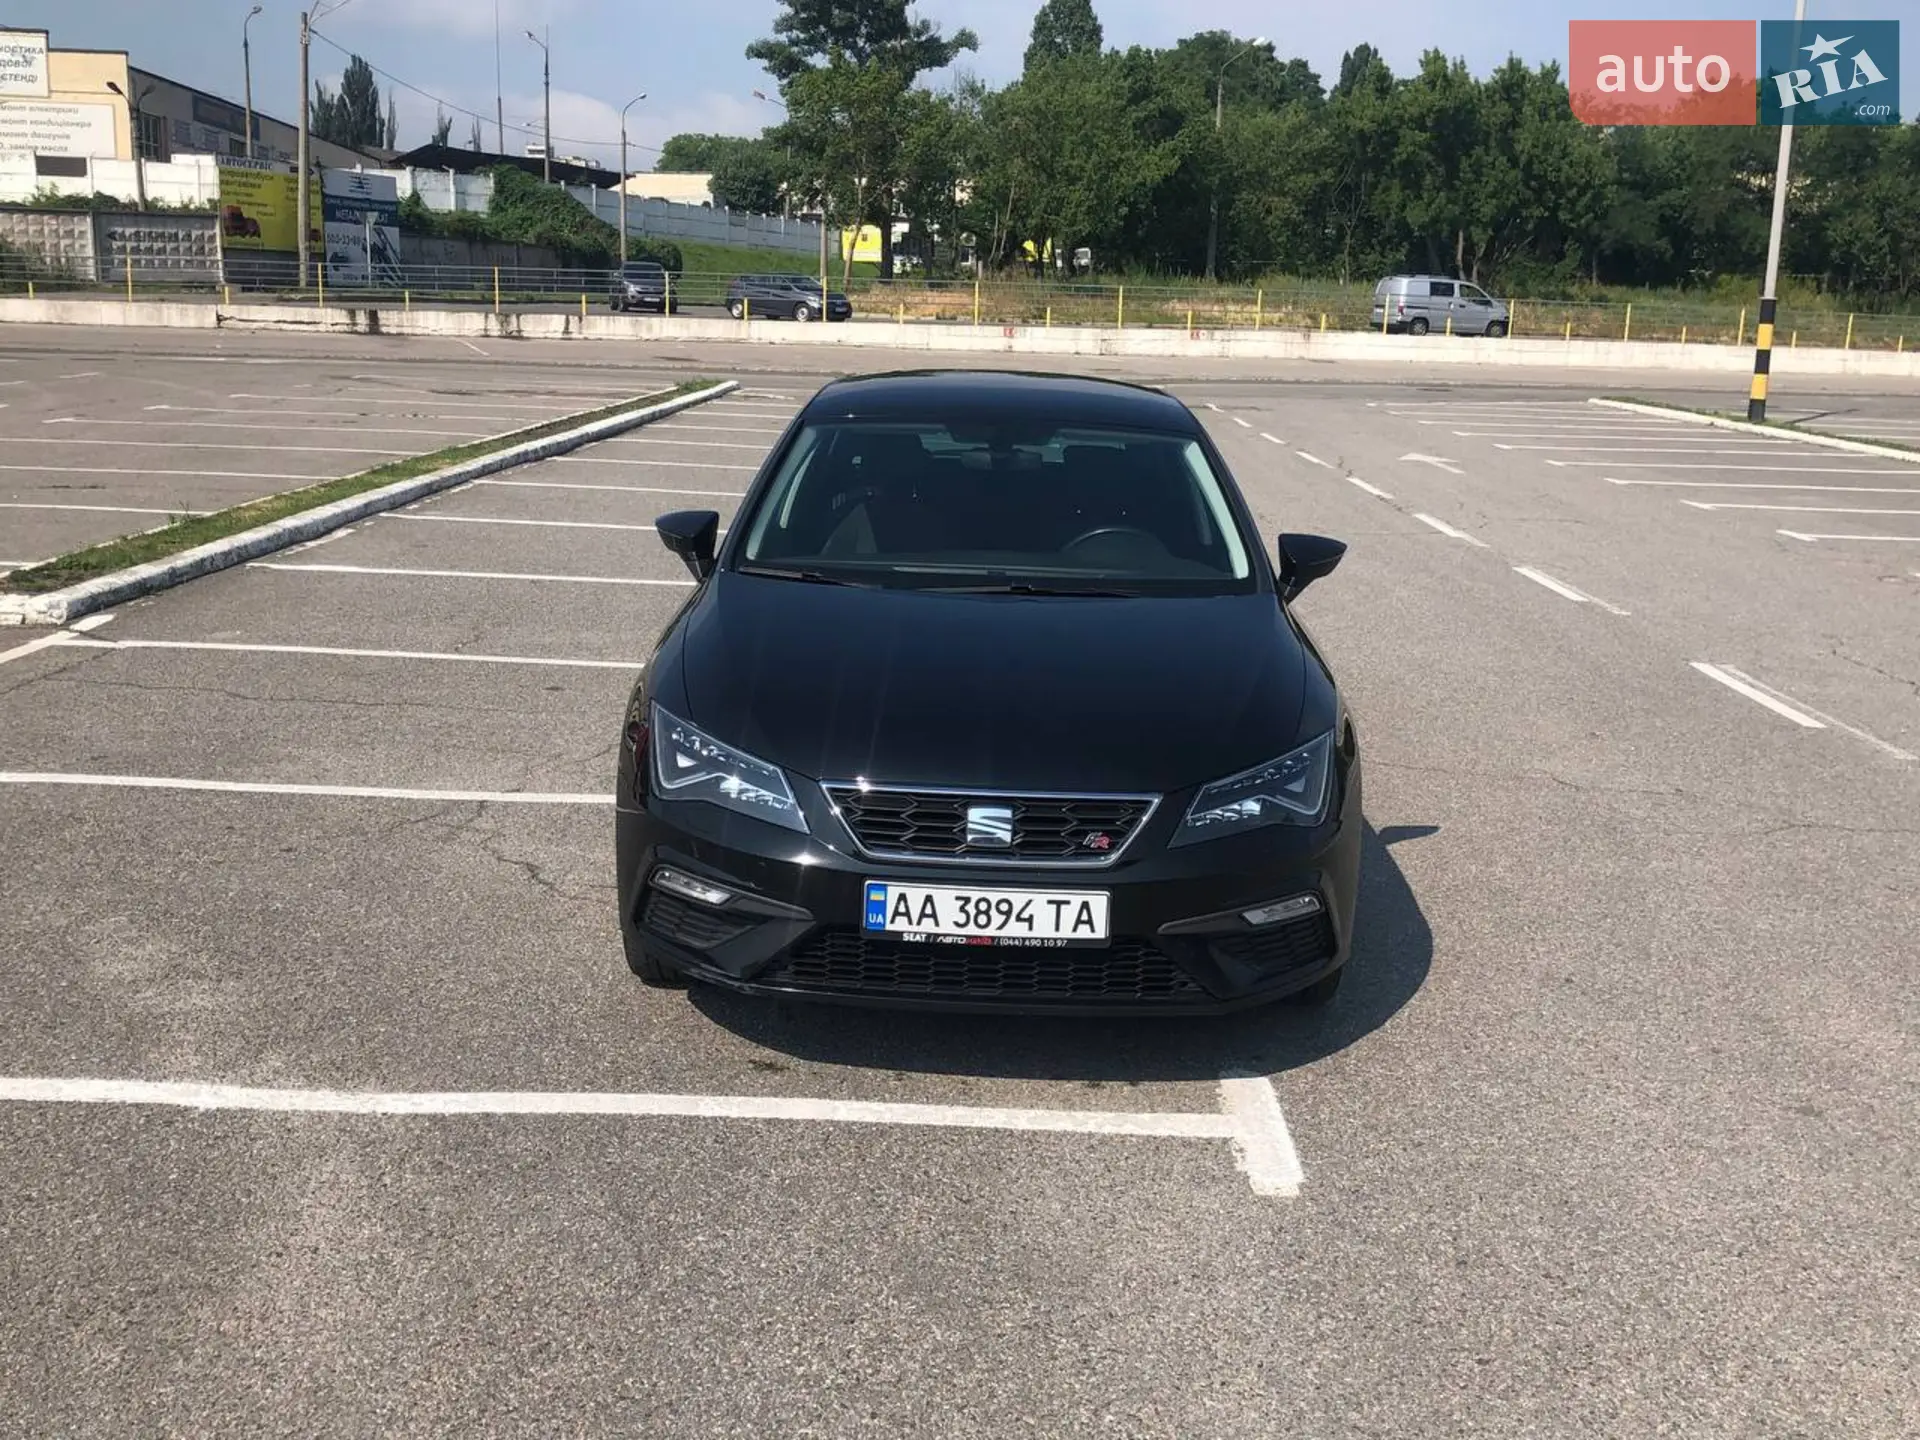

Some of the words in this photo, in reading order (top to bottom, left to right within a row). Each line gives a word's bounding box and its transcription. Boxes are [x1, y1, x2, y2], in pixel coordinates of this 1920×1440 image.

[868, 913, 884, 924] UA
[889, 892, 940, 927] AA
[952, 895, 1034, 932] 3894
[1046, 899, 1096, 934] TA
[902, 932, 928, 943] SEAT
[1000, 937, 1023, 948] (044)
[1024, 938, 1042, 948] 490
[1044, 939, 1055, 948] 10
[1055, 939, 1068, 948] 97
